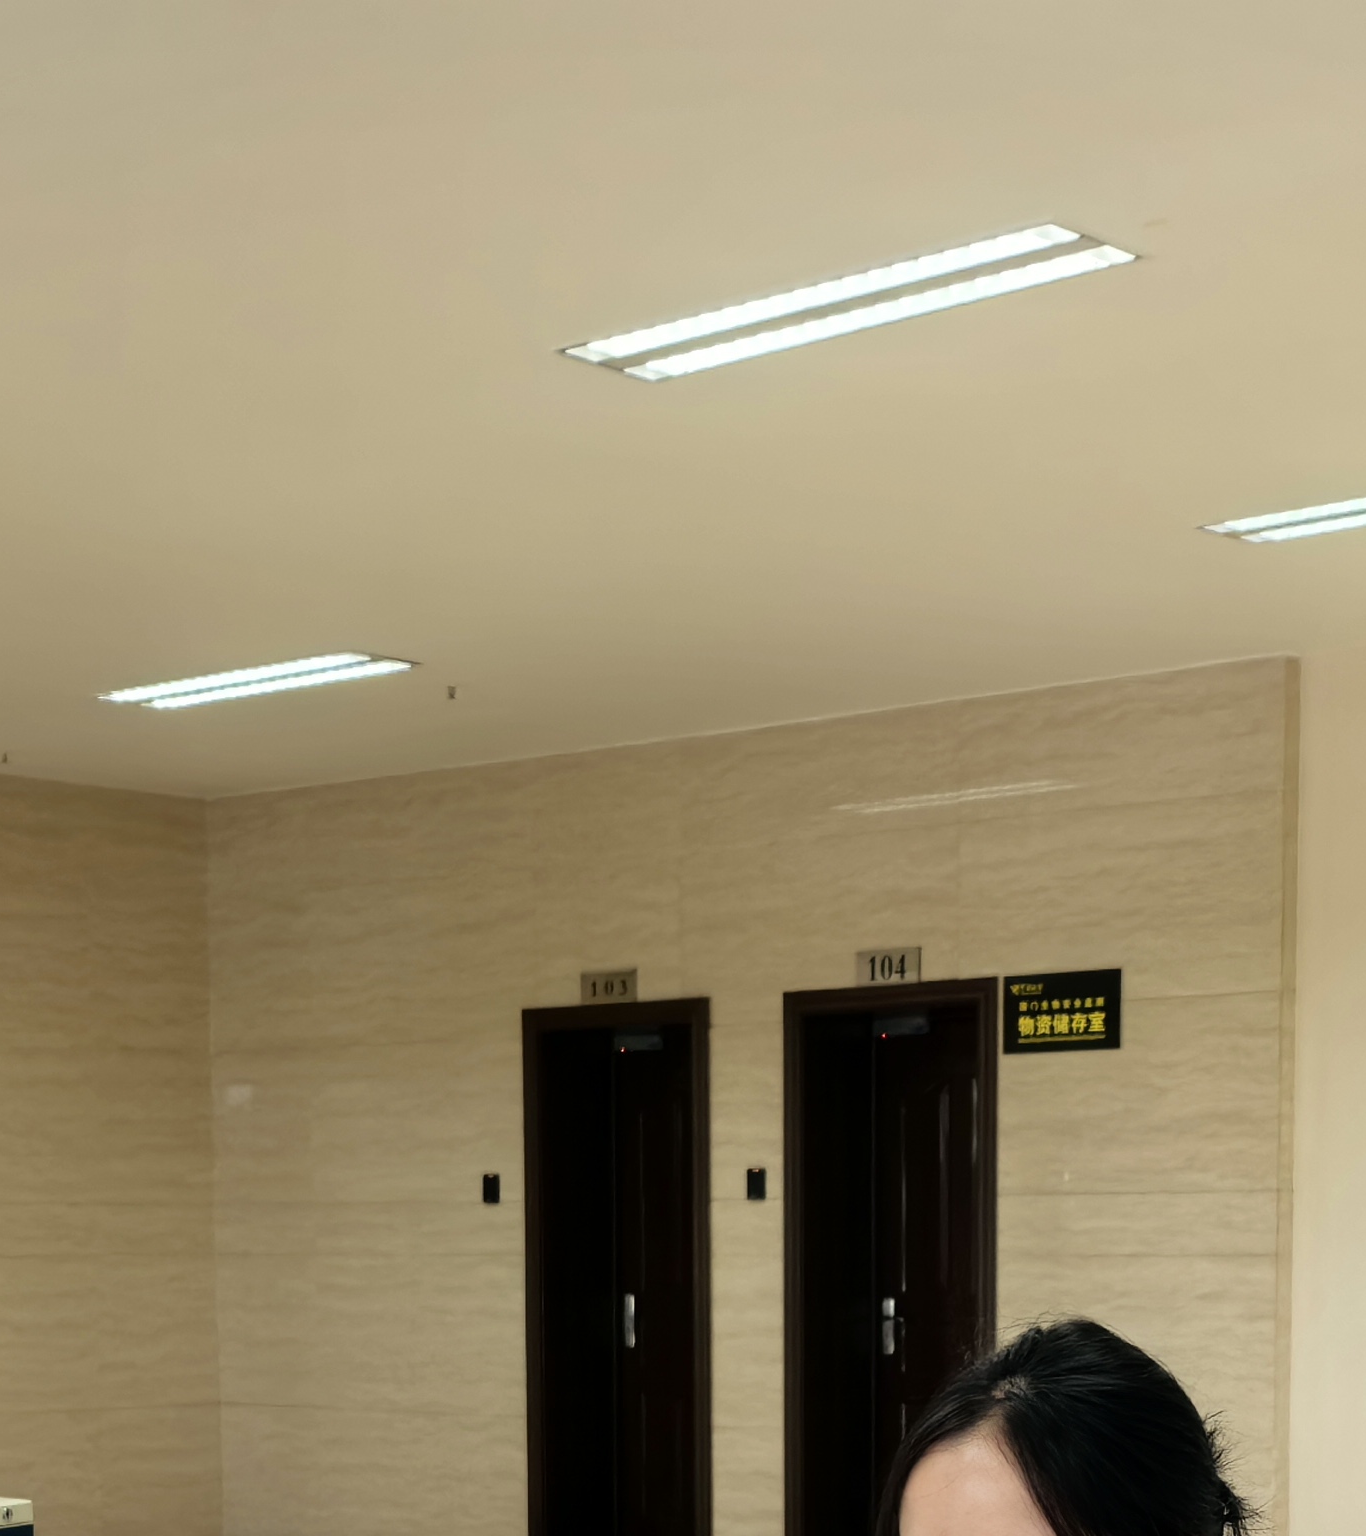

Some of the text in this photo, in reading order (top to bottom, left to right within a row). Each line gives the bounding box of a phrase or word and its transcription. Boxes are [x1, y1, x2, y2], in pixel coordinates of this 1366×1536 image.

[868, 955, 907, 982] 104
[590, 979, 628, 998] 103
[1018, 1011, 1106, 1037] 物资储存室
